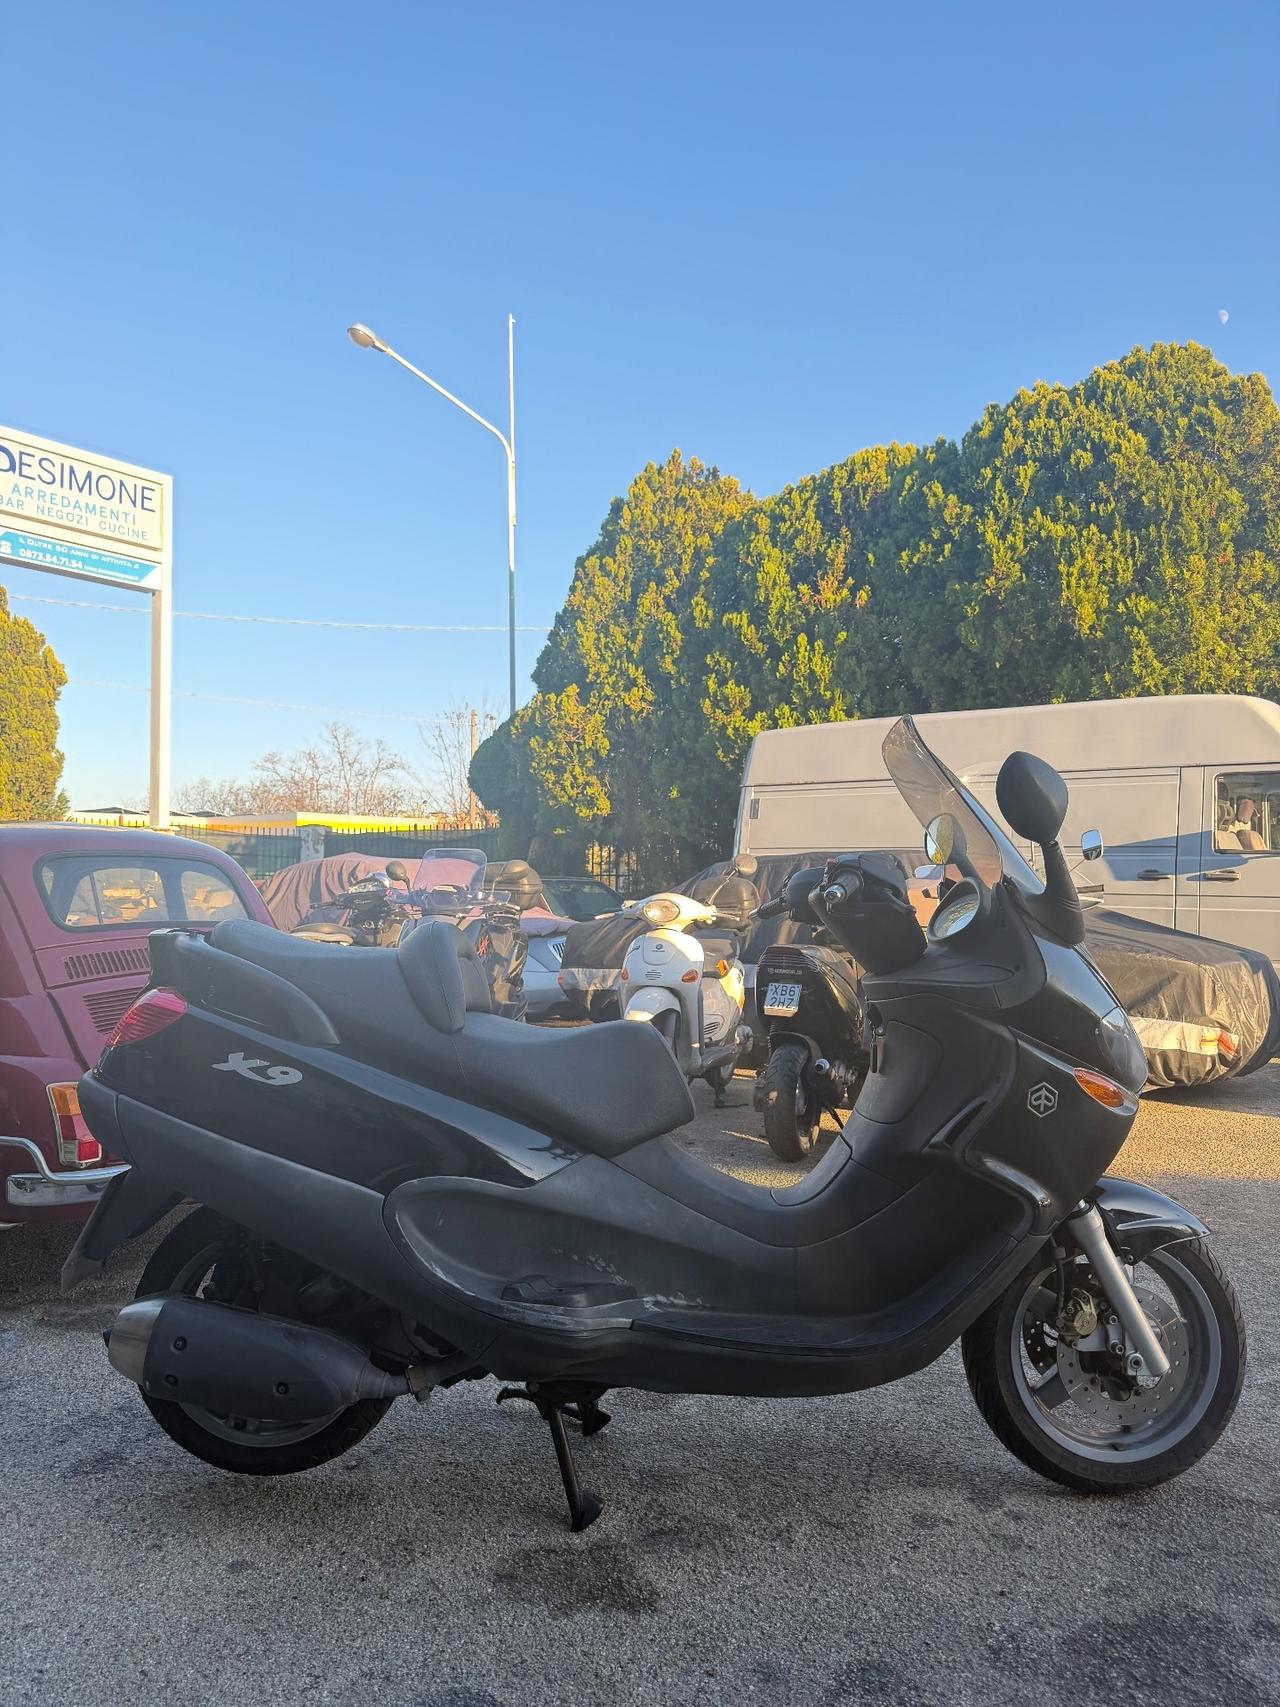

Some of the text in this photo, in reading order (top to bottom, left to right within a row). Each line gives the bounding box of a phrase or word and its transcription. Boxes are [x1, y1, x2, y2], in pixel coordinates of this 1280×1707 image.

[11, 482, 136, 526] ARREDAMENTI
[36, 503, 89, 527] NEGOZI
[99, 520, 148, 541] CUCINE
[772, 984, 796, 997] XB6
[211, 1051, 303, 1086] X9
